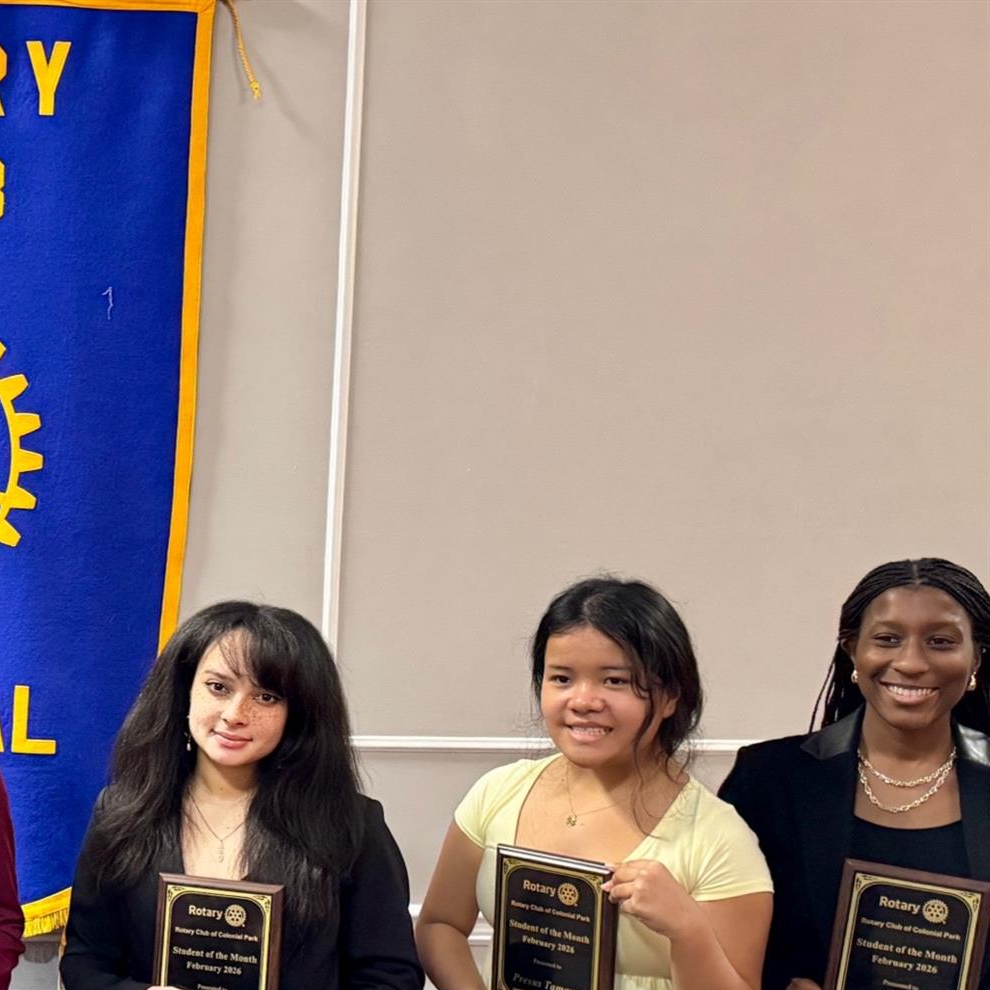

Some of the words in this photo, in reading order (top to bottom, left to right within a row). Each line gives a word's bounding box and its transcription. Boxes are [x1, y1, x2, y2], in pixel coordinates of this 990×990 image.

[523, 880, 556, 897] Rotary
[188, 904, 223, 920] Rotary
[879, 896, 921, 914] Rotary
[175, 926, 195, 935] Rotary
[196, 928, 210, 936] Club
[218, 931, 243, 940] Colonial
[509, 920, 538, 932] Student
[540, 927, 549, 935] of
[549, 928, 562, 937] the
[563, 931, 590, 944] Month
[861, 917, 885, 928] Rotary
[886, 921, 903, 930] Club
[912, 926, 943, 938] Colonial
[944, 932, 960, 940] Park
[522, 935, 556, 951] February
[557, 943, 575, 954] 2026
[856, 938, 894, 951] Student
[895, 945, 907, 953] of
[907, 947, 923, 957] the
[925, 950, 958, 964] Month
[172, 946, 204, 957] Student
[215, 952, 228, 960] the
[230, 953, 257, 964] Month
[186, 961, 222, 974] February
[223, 965, 242, 975] 2026
[871, 955, 914, 971] February
[915, 963, 938, 974] 2026
